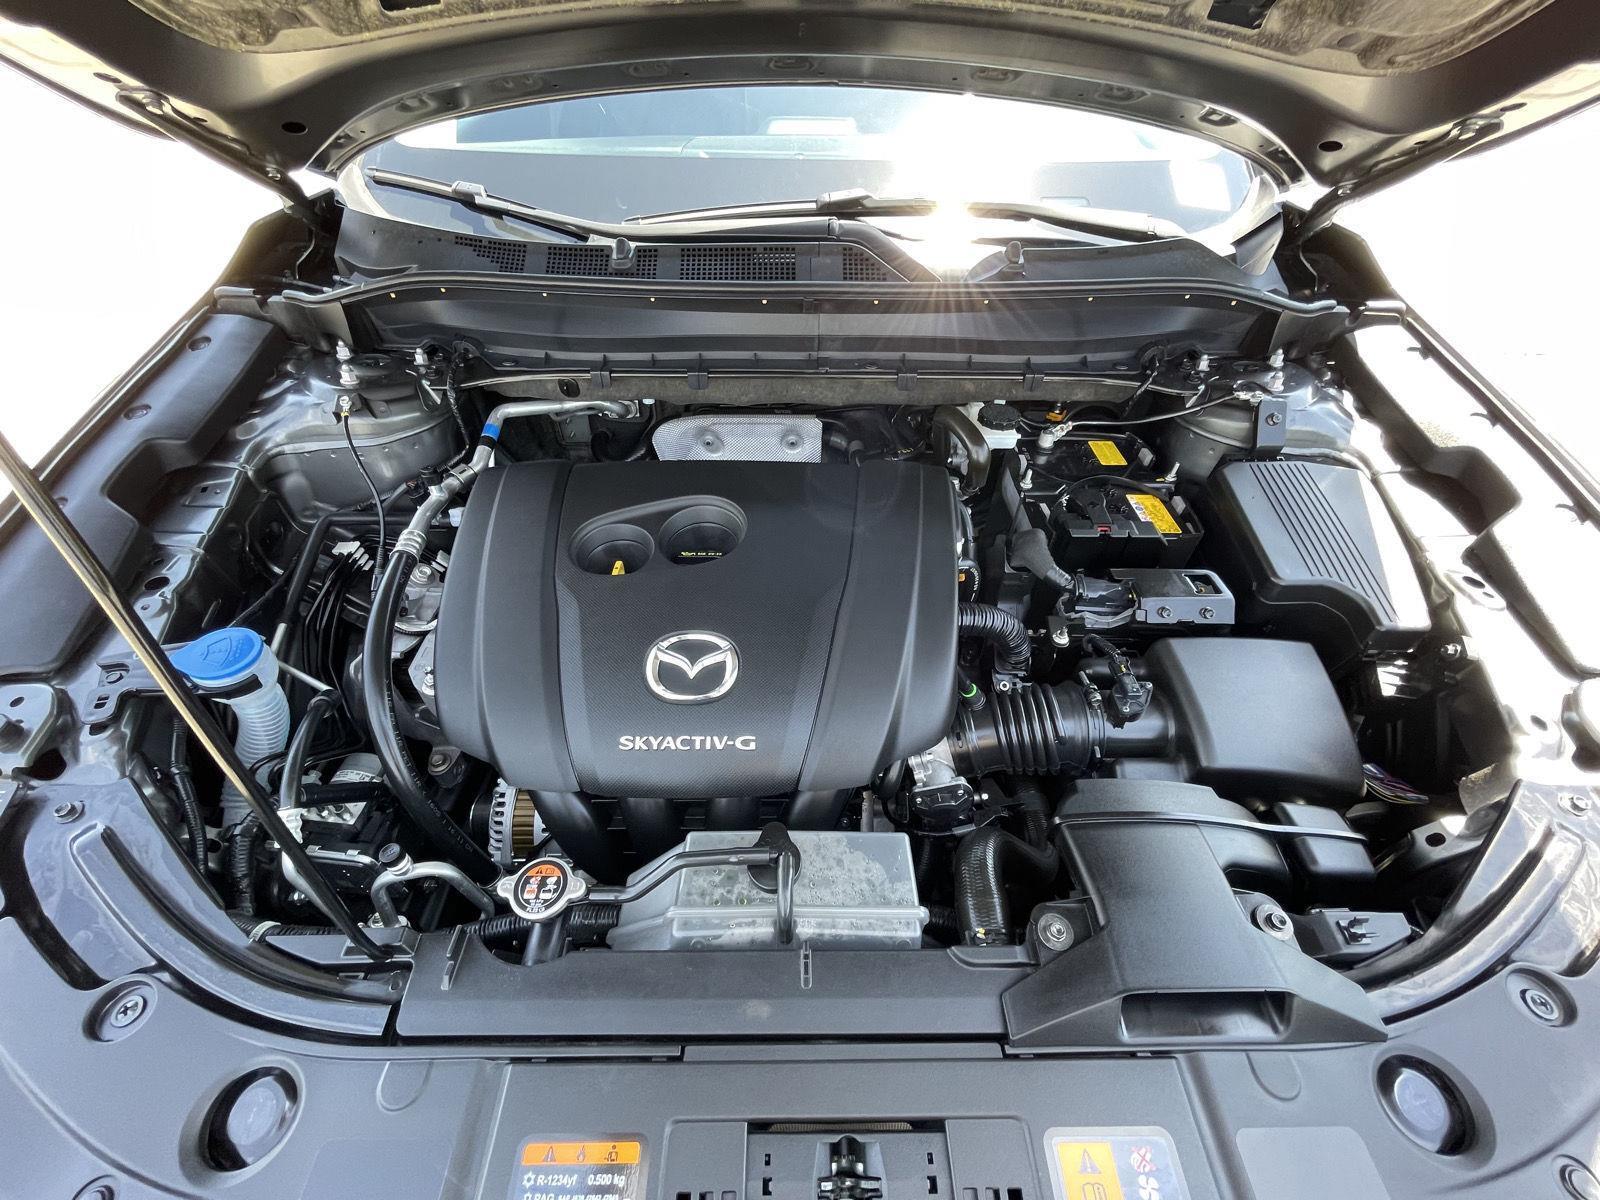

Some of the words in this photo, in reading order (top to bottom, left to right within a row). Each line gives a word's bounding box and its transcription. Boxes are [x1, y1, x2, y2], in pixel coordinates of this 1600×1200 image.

[618, 735, 757, 751] SKYACTIV-G
[536, 1173, 578, 1188] R-1234yf
[587, 1173, 612, 1186] 0.500
[613, 1173, 626, 1188] kg
